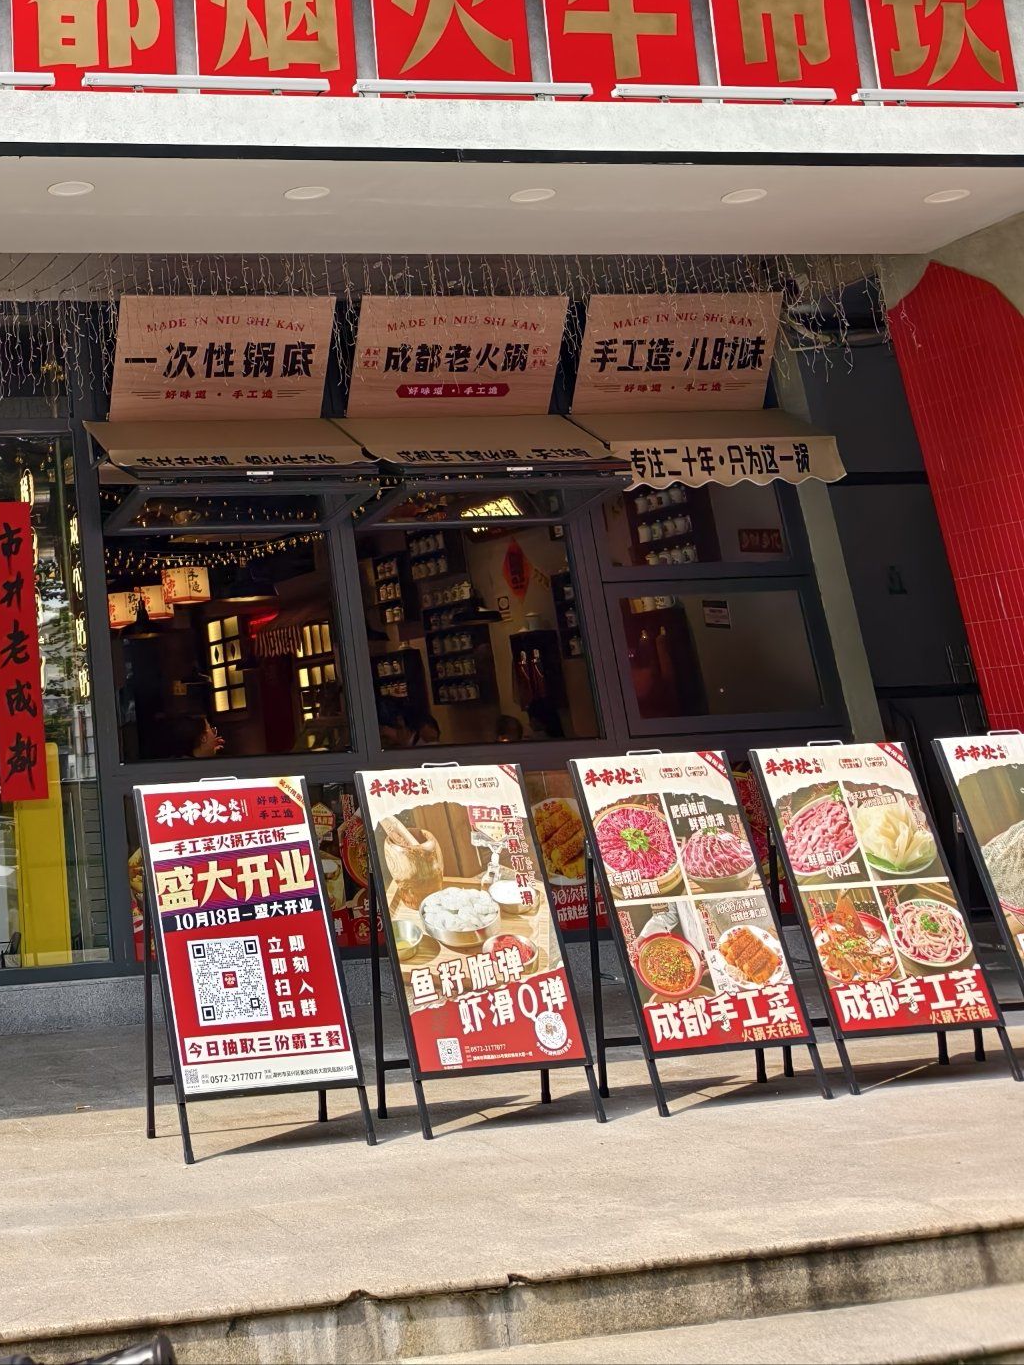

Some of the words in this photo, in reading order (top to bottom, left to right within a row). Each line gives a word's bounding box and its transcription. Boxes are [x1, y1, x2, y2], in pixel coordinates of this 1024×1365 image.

[125, 341, 316, 379] 一次性锅底
[383, 343, 530, 373] 成都老火锅
[590, 336, 766, 373] 手工造·儿时味
[630, 443, 811, 479] 专注二十年·只为这一锅
[156, 847, 315, 913] 盛大开业
[410, 945, 525, 1006] 鱼籽脆弹
[458, 975, 569, 1036] 虾滑Q弹
[649, 984, 799, 1045] 成都手工菜
[836, 968, 987, 1024] 成都手工菜
[929, 1004, 993, 1025] 火锅天花板
[188, 1030, 341, 1059] 今日抽取三份霸王餐
[741, 1020, 804, 1043] 火锅天花板
[210, 1071, 262, 1084] 0572-2177077
